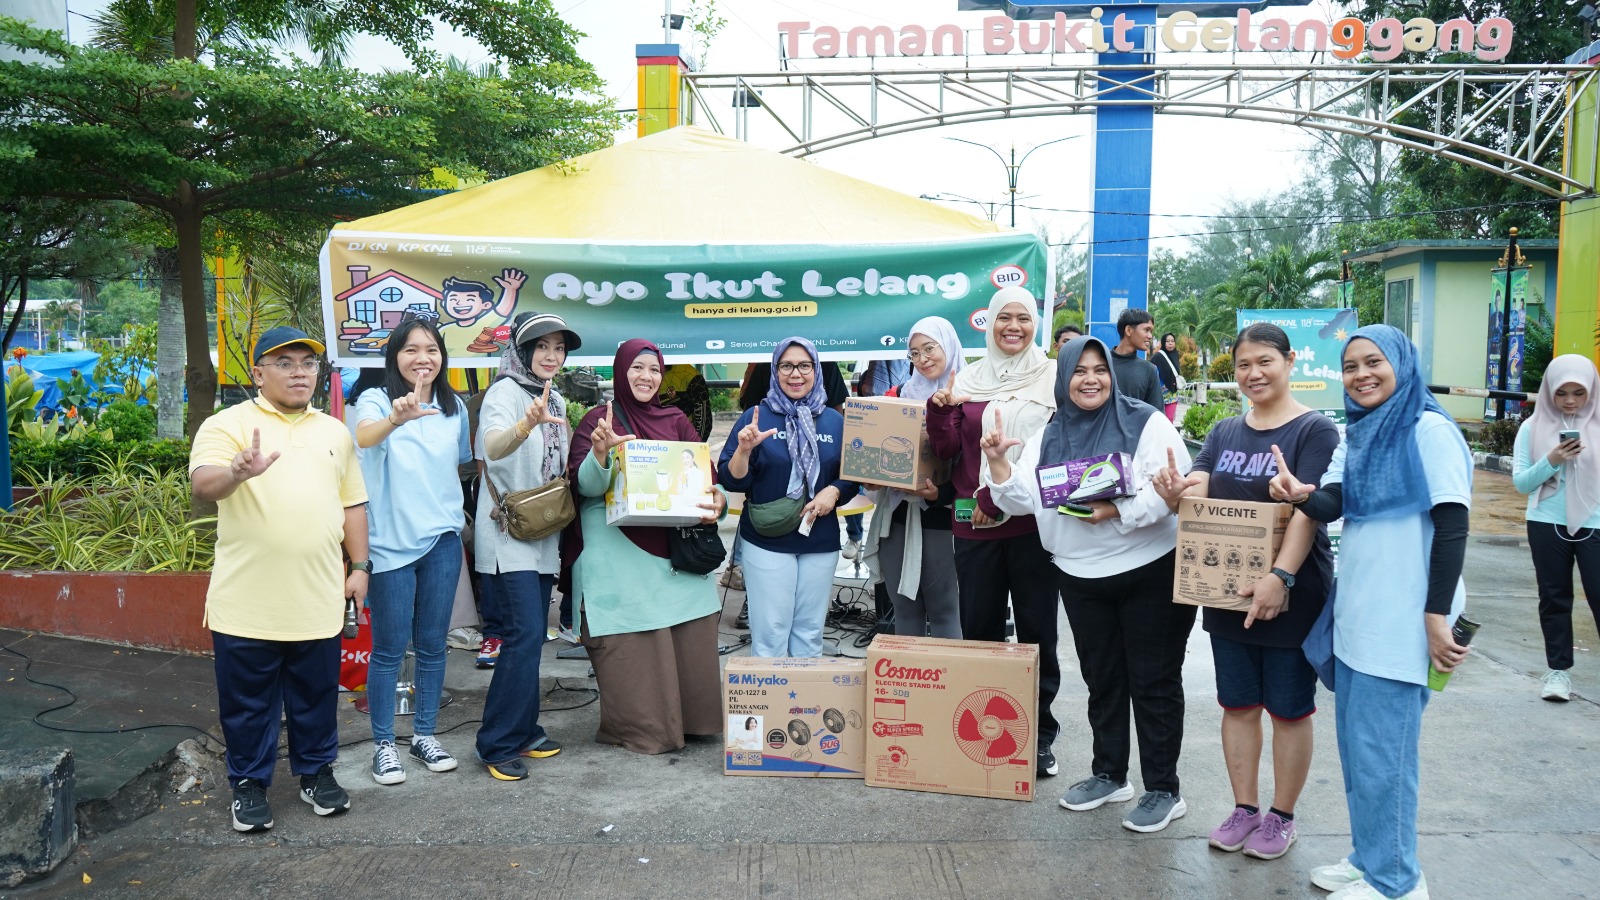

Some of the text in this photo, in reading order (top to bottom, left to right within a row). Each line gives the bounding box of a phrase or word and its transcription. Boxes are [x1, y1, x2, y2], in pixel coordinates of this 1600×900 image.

[778, 6, 1515, 62] Taman Bukit Gelanggang
[397, 242, 453, 253] KPKNL
[996, 272, 1021, 283] BID
[543, 267, 971, 306] Ayo Ikut Lelang
[692, 307, 724, 315] hanya
[740, 306, 802, 314] lelang.go.id
[974, 316, 987, 327] BI
[730, 341, 758, 349] Seroja
[829, 338, 857, 346] Dumai
[1302, 362, 1344, 382] Lelan
[853, 401, 879, 412] Miyako
[636, 442, 668, 454] Miyako
[1042, 473, 1066, 481] PHILIPS
[1208, 506, 1257, 519] VICENTE
[874, 658, 943, 682] Cosmos
[741, 674, 789, 688] Miyako
[892, 689, 910, 698] SDB
